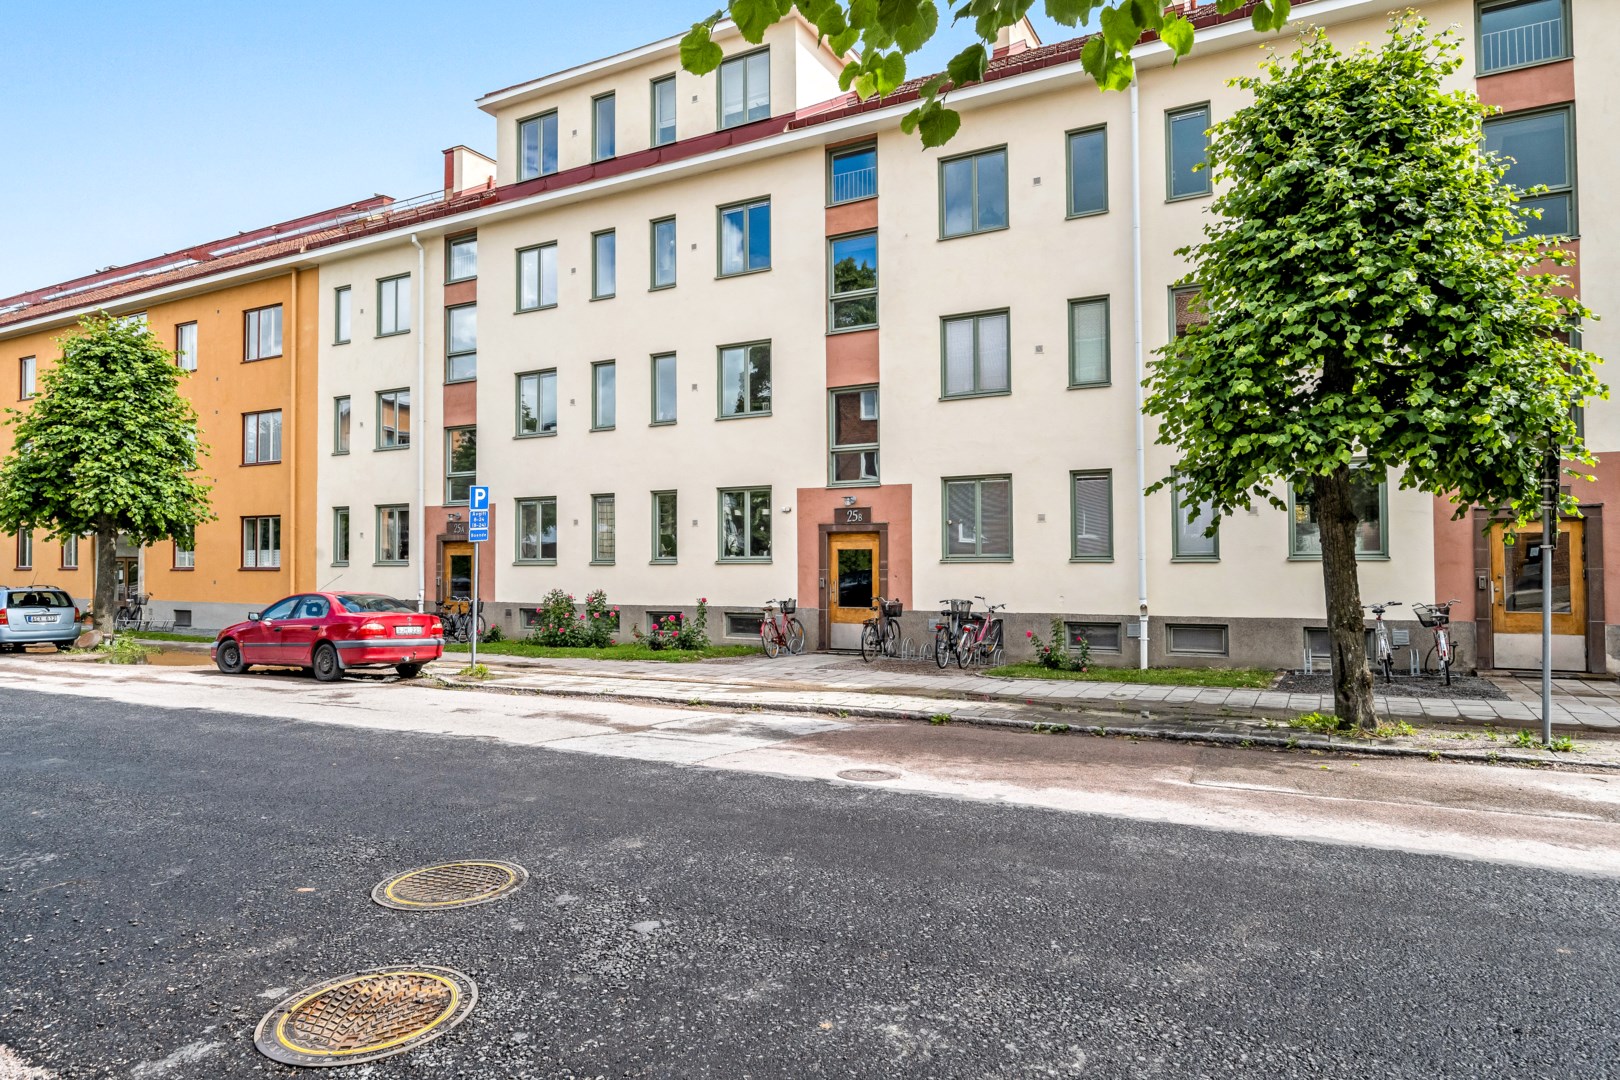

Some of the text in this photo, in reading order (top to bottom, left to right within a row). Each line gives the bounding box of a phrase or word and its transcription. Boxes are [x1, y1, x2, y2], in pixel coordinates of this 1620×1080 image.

[474, 488, 486, 508] P
[846, 510, 863, 522] 25B
[453, 524, 465, 533] 25A
